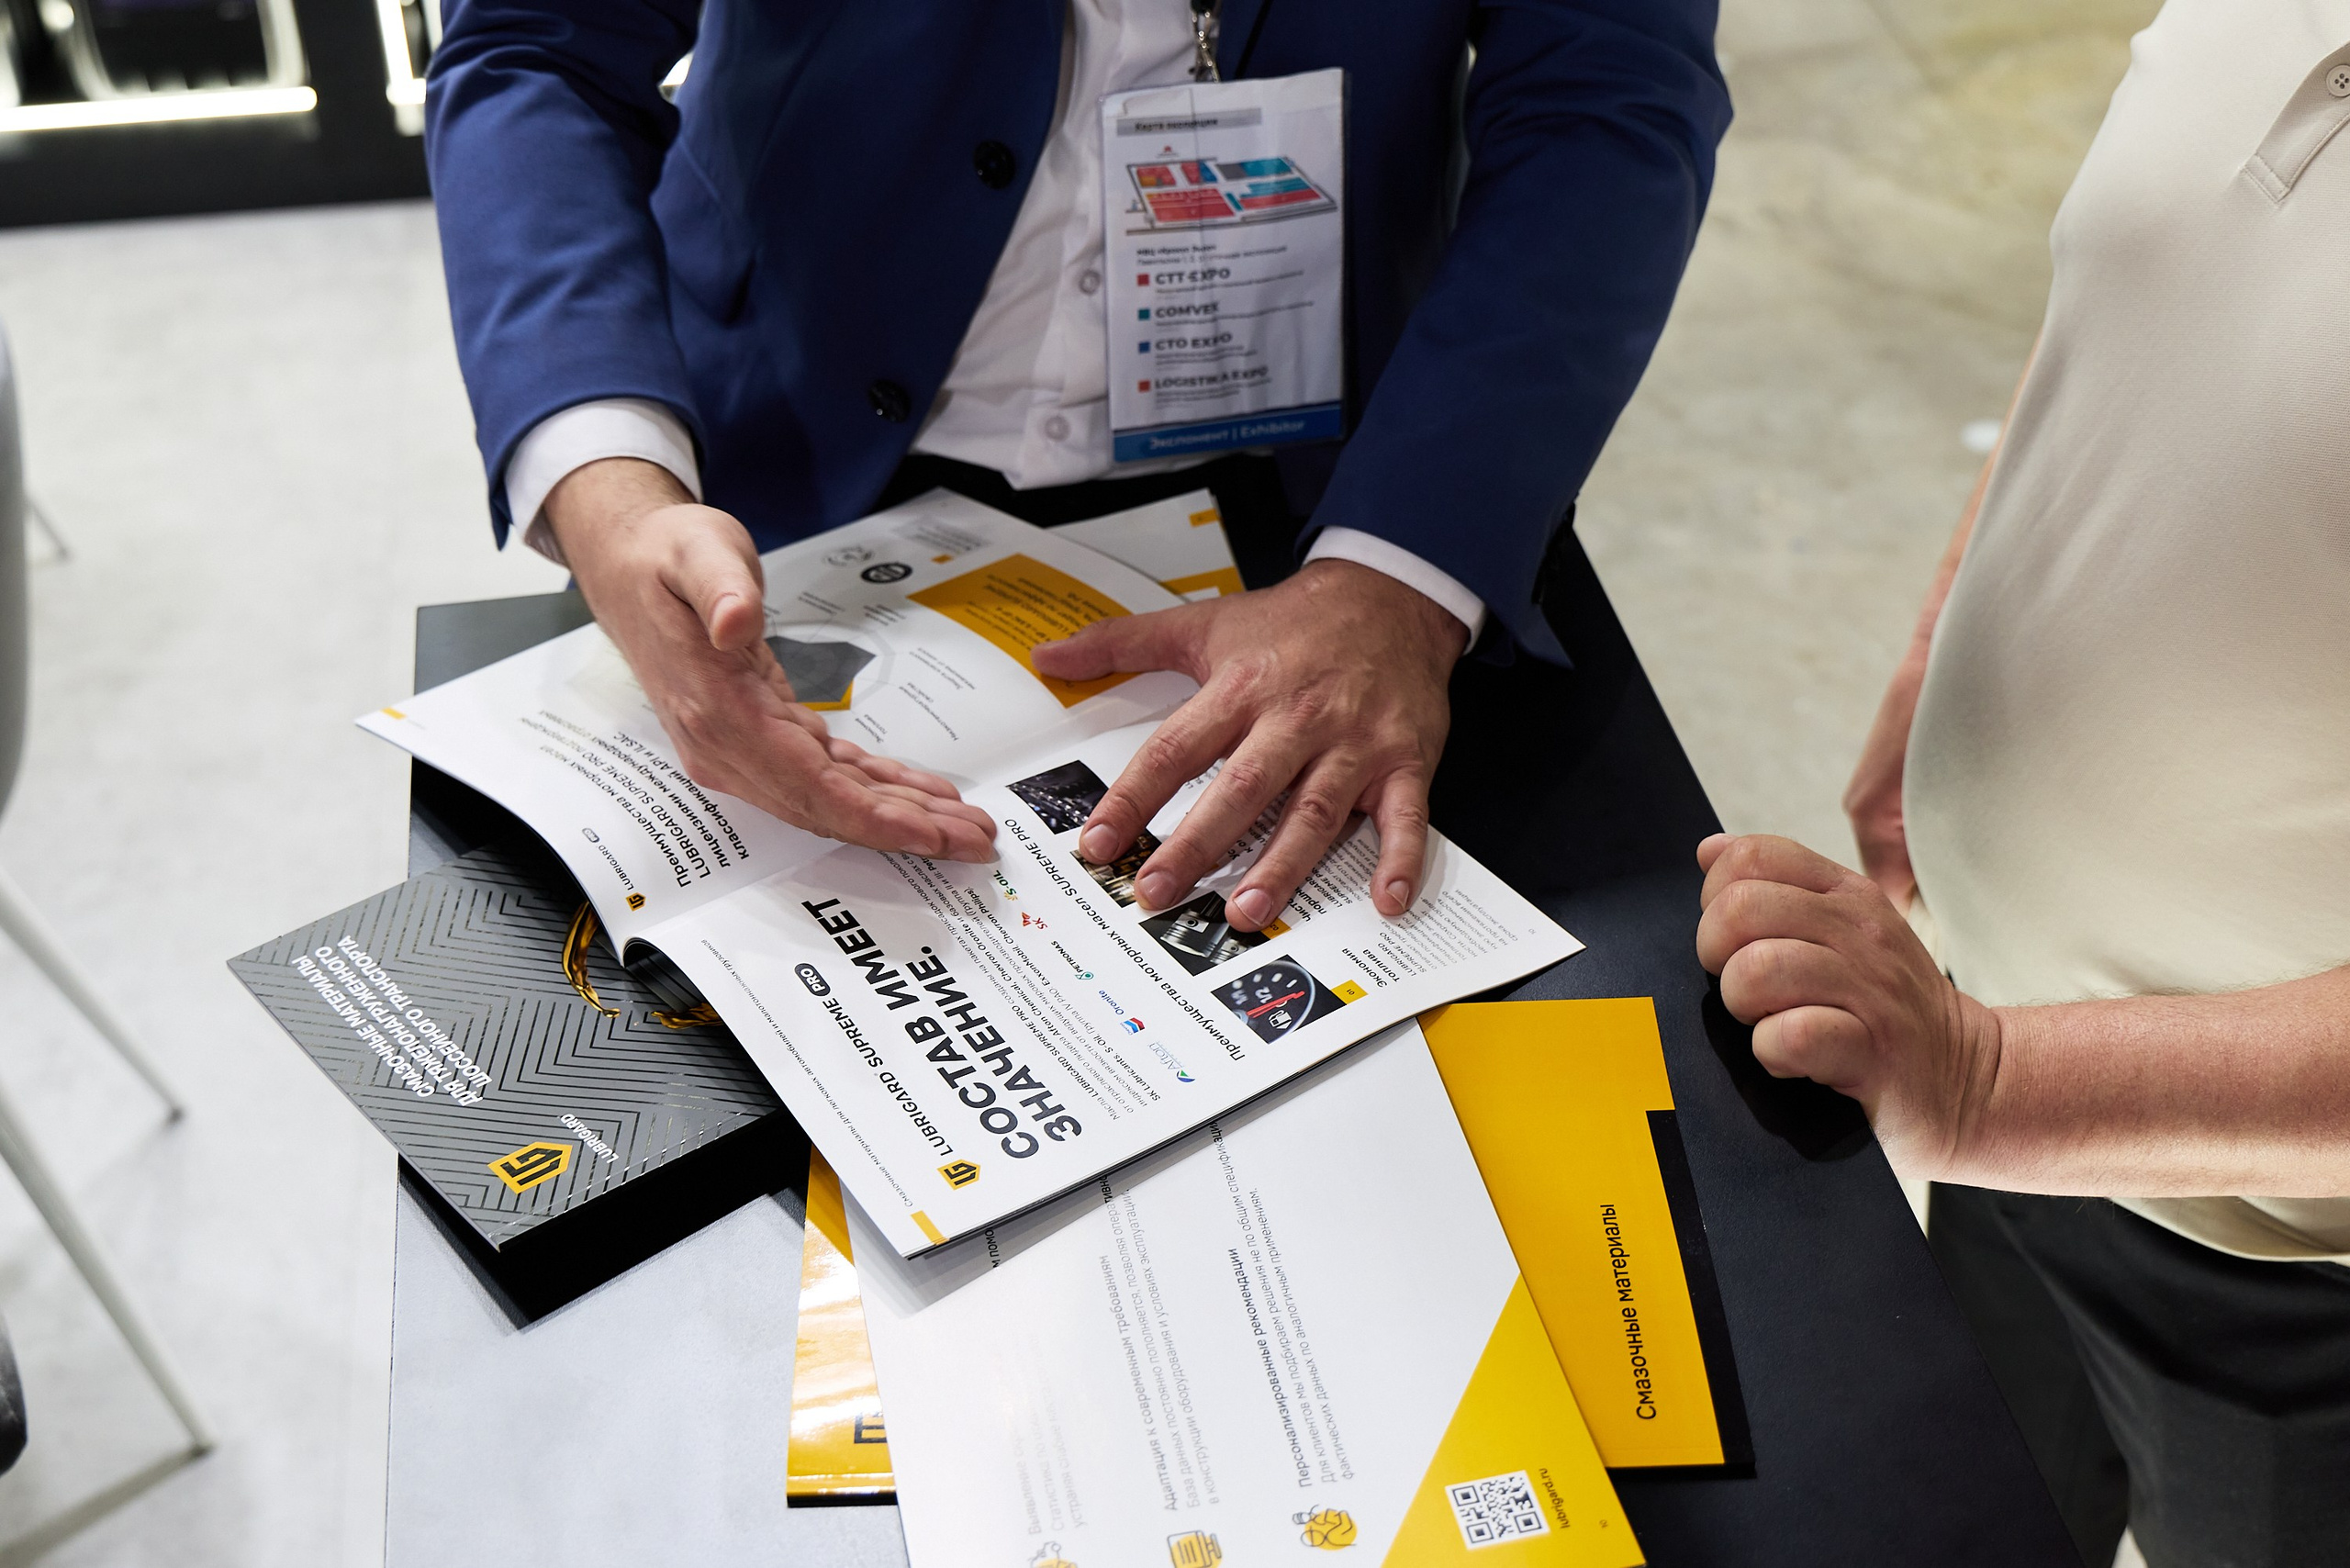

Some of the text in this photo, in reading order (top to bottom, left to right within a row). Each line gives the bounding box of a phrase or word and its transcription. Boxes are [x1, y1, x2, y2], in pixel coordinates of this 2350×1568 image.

[570, 762, 619, 797] моторных
[649, 756, 672, 770] API
[581, 752, 711, 879] LUBRIGARD SUPREME PRO
[599, 740, 731, 868] лицензиями международных
[669, 770, 750, 860] классификаций
[616, 797, 692, 888] Преимущества
[1004, 819, 1031, 841] PRO
[599, 846, 634, 890] LUBRIGARD
[912, 864, 935, 888] маслах
[991, 869, 1017, 895] S-OIL
[1024, 842, 1077, 896] SUPREME
[907, 878, 931, 902] нового
[932, 888, 959, 917] базовых
[949, 890, 977, 916] (Группа
[1291, 885, 1326, 914] поршн
[1303, 873, 1343, 907] LUBRIGARD
[1320, 877, 1353, 904] SUPREME
[927, 901, 957, 935] присадок
[1032, 917, 1047, 930] SK
[1075, 897, 1110, 930] масел
[1268, 921, 1279, 931] 02
[1284, 897, 1311, 922] Чисто
[960, 923, 987, 951] Oronite
[970, 913, 1024, 974] производителей
[987, 913, 1014, 944] Chevron
[955, 935, 981, 964] пакетах
[983, 950, 1013, 981] Chevron
[1012, 946, 1050, 986] ExxonMobil,
[1051, 941, 1083, 973] PETRONAS
[1107, 930, 1163, 982] моторных
[1362, 947, 1401, 983] топлива
[1378, 943, 1416, 977] LUBRIGARD
[1379, 932, 1427, 973] SUPREME PRO
[1406, 944, 1438, 969] отвечают
[799, 967, 826, 992] PRO
[979, 964, 990, 973] на
[1342, 948, 1387, 988] Экономия
[987, 974, 1015, 1004] созданы
[1011, 981, 1042, 1016] Chemical,
[1021, 974, 1051, 1005] мировых
[1097, 990, 1125, 1015] Oronite
[337, 935, 493, 1088] ШОССЕЙНОГО ТРАНСПОРТА
[1011, 1004, 1029, 1021] PRO
[1048, 1003, 1080, 1035] ведущих
[1062, 1002, 1073, 1011] IV
[1070, 1009, 1096, 1035] Группа
[1160, 982, 1246, 1061] Преимущества
[291, 955, 435, 1097] СМАЗОЧНЫЕ МАТЕРИАЛЫ
[315, 946, 483, 1106] ДЛЯ ТЯЖЕЛОНАГРУЖЕННОГО
[800, 898, 1039, 1159] СОСТАВ ИМЕЕТ
[822, 998, 883, 1068] SUPREME
[1025, 1021, 1060, 1057] SUPREME
[1039, 1015, 1061, 1036] Afton
[1075, 1035, 1086, 1043] от
[776, 1029, 814, 1075] автомобилей
[905, 946, 1082, 1142] ЗНАЧЕНИЕ.
[1059, 1036, 1084, 1061] лидера
[1084, 1044, 1115, 1074] вязкости
[1147, 1041, 1180, 1071] Afton
[1058, 1056, 1099, 1098] LUBRIGARD
[1082, 1061, 1125, 1104] отраслевого
[1113, 1055, 1150, 1091] Lubricants,
[810, 1076, 840, 1110] легковых
[1113, 1074, 1147, 1107] индексом
[1147, 1090, 1161, 1101] SK
[835, 1110, 851, 1125] для
[879, 1071, 954, 1156] LUBRIGARD
[1097, 1097, 1121, 1120] Масла
[1123, 1104, 1134, 1114] от
[557, 1114, 620, 1164] LUBRIGARD
[847, 1125, 881, 1165] материалы
[878, 1166, 913, 1207] Смазочные
[1118, 1186, 1150, 1263] эксплуатации.
[1232, 1194, 1252, 1231] общим
[1244, 1234, 1257, 1247] по
[1249, 1249, 1261, 1262] не
[1115, 1238, 1137, 1288] позволяя
[1143, 1266, 1168, 1317] условиях
[1255, 1265, 1281, 1314] решения
[1131, 1289, 1159, 1363] пополняется,
[1600, 1204, 1657, 1420] Смазочные материалы
[1249, 1188, 1355, 1480] фактических данных по аналогичным применениям.
[1271, 1316, 1300, 1380] подбираем
[1100, 1255, 1178, 1511] Адаптация к современным требованиям
[1161, 1330, 1193, 1413] оборудования
[1228, 1249, 1312, 1487] Персонализированные рекомендации
[1152, 1366, 1178, 1428] постоянно
[1292, 1382, 1306, 1399] мы
[1300, 1402, 1326, 1457] клиентов
[1170, 1430, 1193, 1474] данных
[1186, 1416, 1216, 1494] конструкции
[1317, 1459, 1337, 1484] Для
[1183, 1477, 1201, 1508] База
[1539, 1467, 1570, 1529] lubrigard.ru
